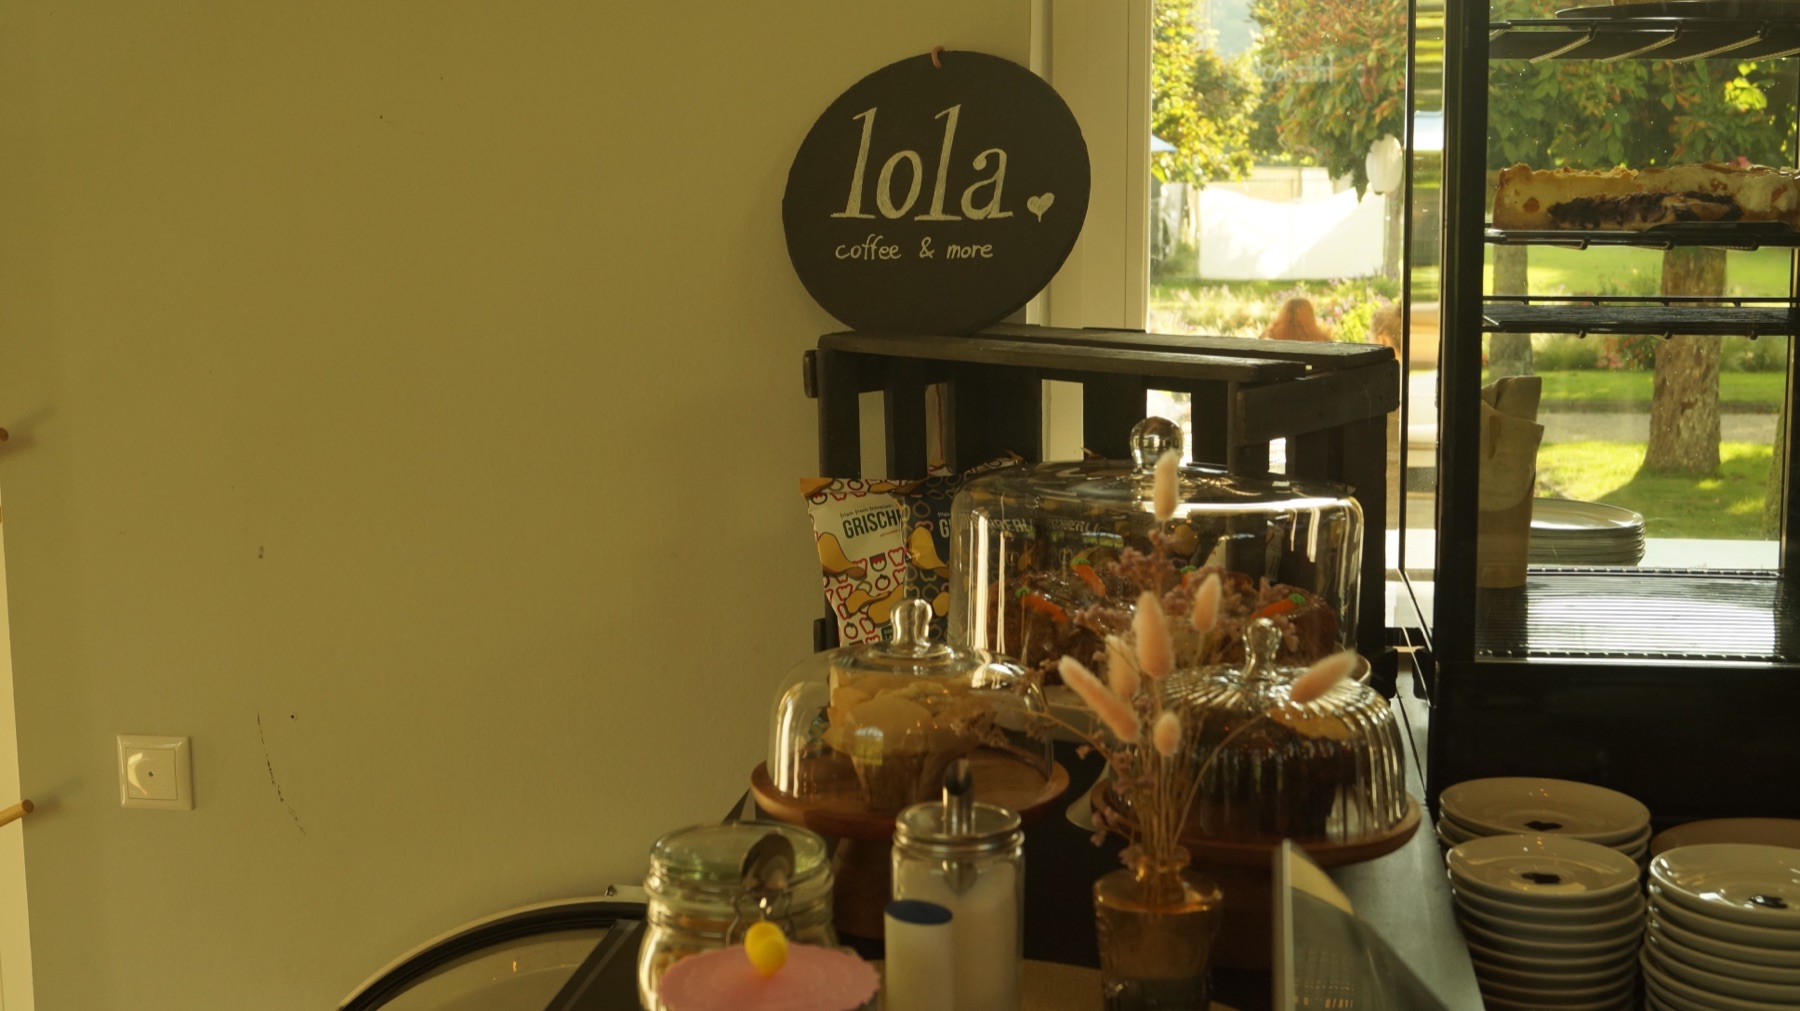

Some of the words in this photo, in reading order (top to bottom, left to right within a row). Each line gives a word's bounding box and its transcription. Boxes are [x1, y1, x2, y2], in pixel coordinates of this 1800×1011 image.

[830, 104, 1014, 221] lola
[835, 234, 902, 260] coffee
[919, 236, 935, 259] &
[946, 243, 993, 259] more
